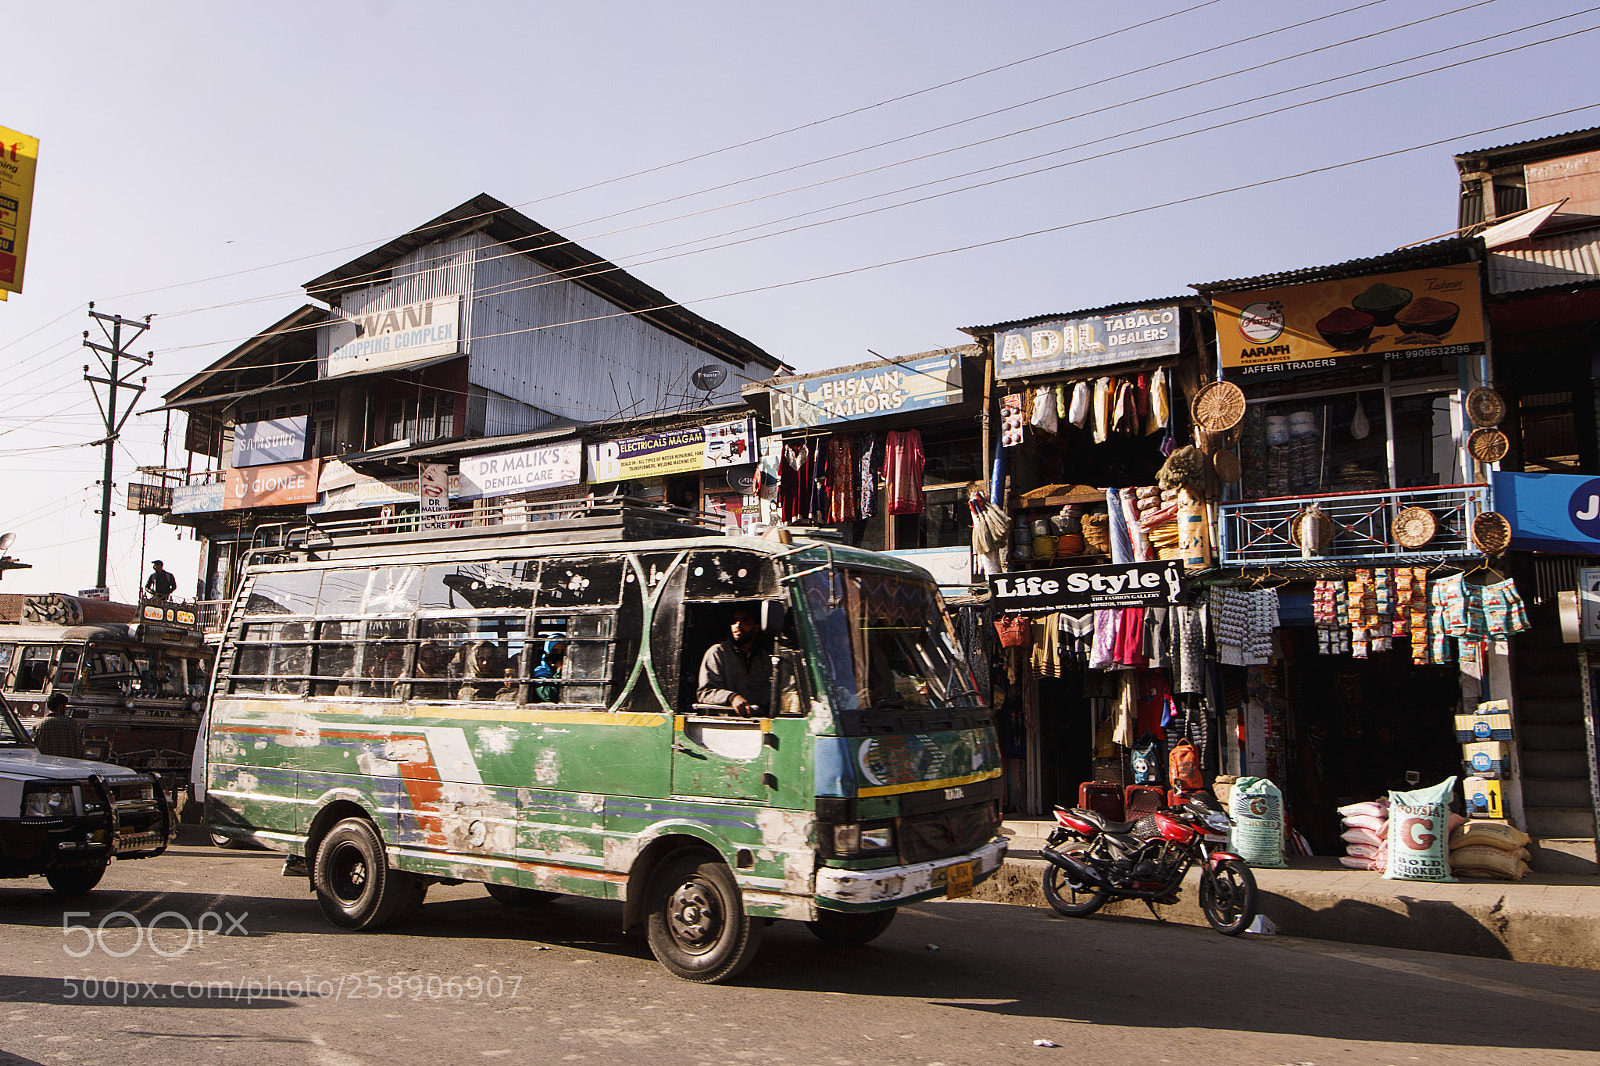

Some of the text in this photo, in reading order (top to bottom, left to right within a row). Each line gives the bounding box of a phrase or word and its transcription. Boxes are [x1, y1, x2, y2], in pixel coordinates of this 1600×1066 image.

[354, 302, 433, 340] WANI
[333, 336, 390, 361] SHOPPING
[394, 323, 453, 349] COMPLEX
[1001, 323, 1106, 366] ADIL
[1104, 311, 1174, 332] TABACO
[1108, 327, 1169, 347] DEALERS
[1241, 345, 1290, 358] AARAFH
[1243, 345, 1470, 375] JAFFERI TRADERS PH: 9906632296
[822, 370, 900, 400] EHSAAN
[823, 390, 903, 420] TAILORS
[239, 432, 296, 452] SAMSUNG
[620, 438, 667, 453] ELECTRICALS
[668, 433, 703, 446] MAGAM
[480, 448, 560, 475] DR MALIK'S
[252, 474, 306, 494] GIONEE
[484, 469, 553, 490] DENTAL CARE
[421, 505, 449, 513] MALIK'S
[994, 569, 1160, 598] Life Style
[1474, 723, 1489, 733] PIR
[1474, 755, 1489, 766] PIR
[1250, 798, 1269, 816] G
[1243, 820, 1277, 828] CHOKER
[1400, 817, 1437, 851] G
[1397, 863, 1442, 876] CHOKER
[1398, 856, 1441, 867] BOLD
